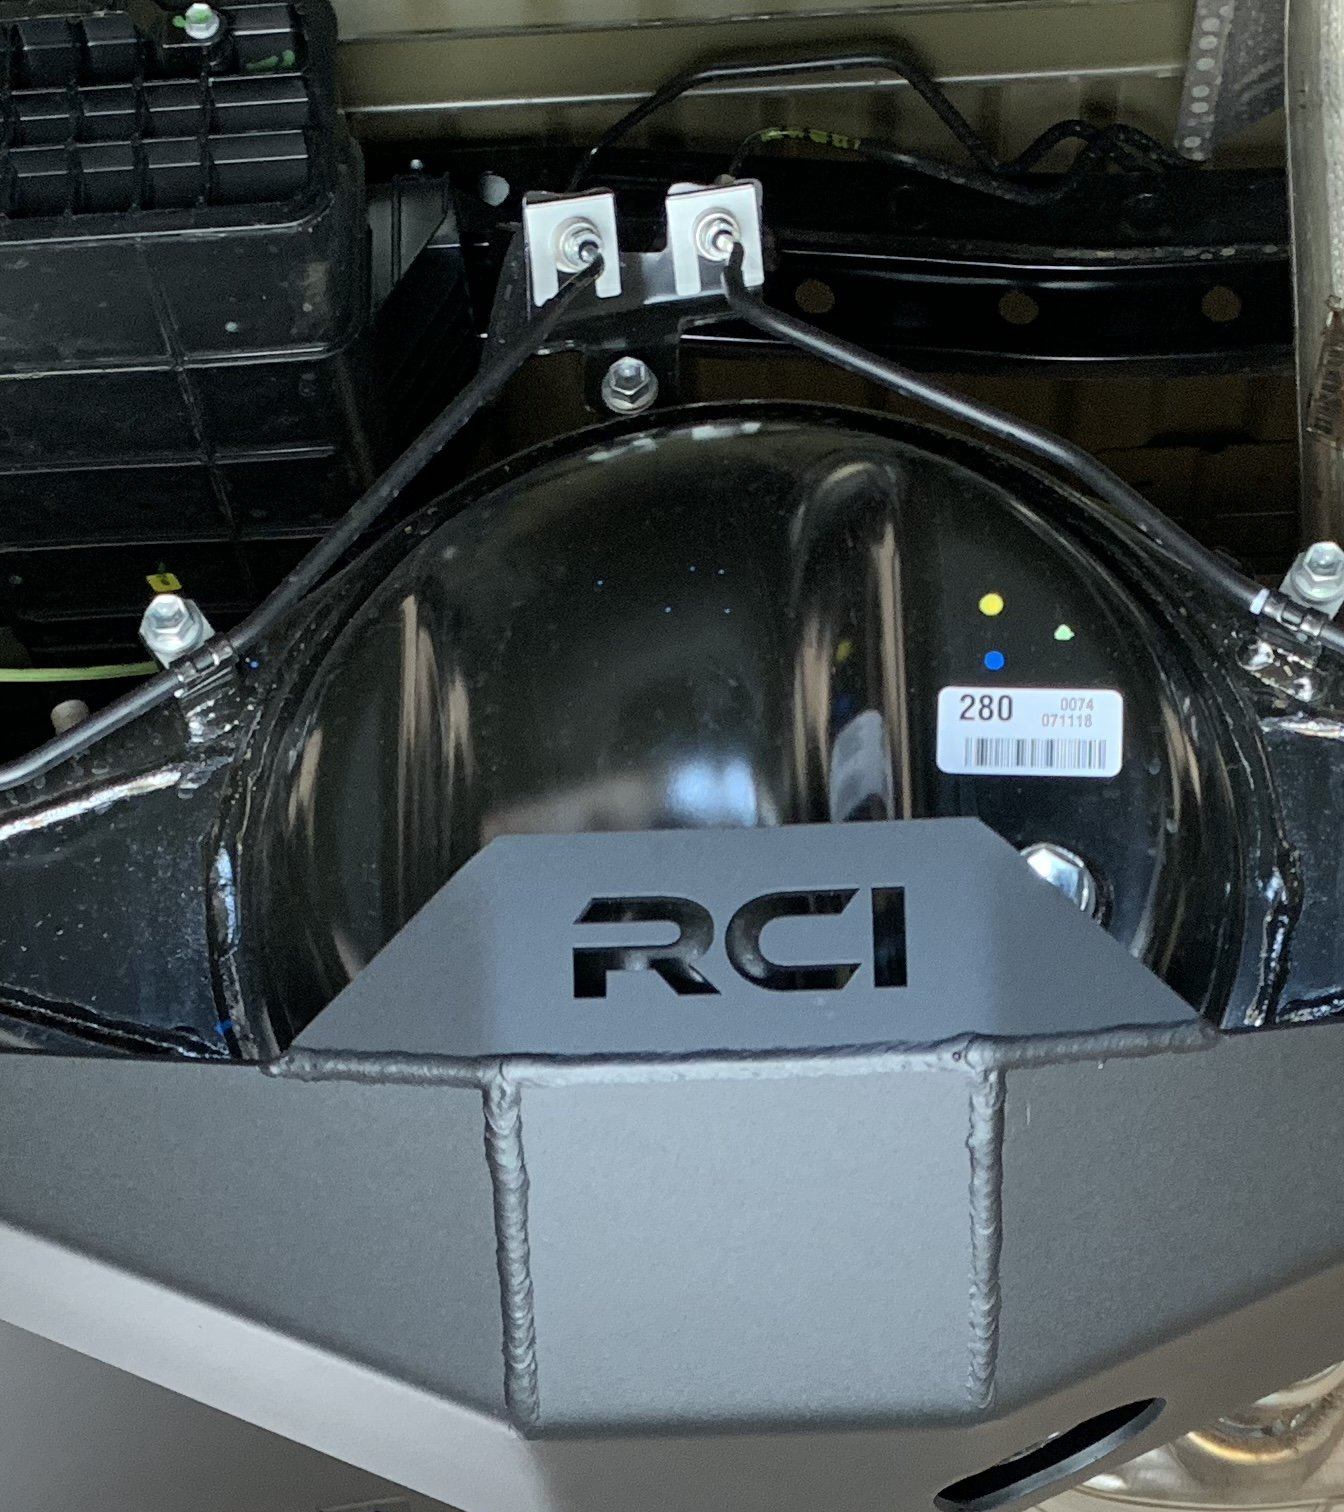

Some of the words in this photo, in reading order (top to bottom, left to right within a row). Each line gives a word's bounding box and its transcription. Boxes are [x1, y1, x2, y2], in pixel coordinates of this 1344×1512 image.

[959, 694, 1013, 722] 280
[1060, 697, 1094, 712] 0074
[572, 885, 908, 999] RCI
